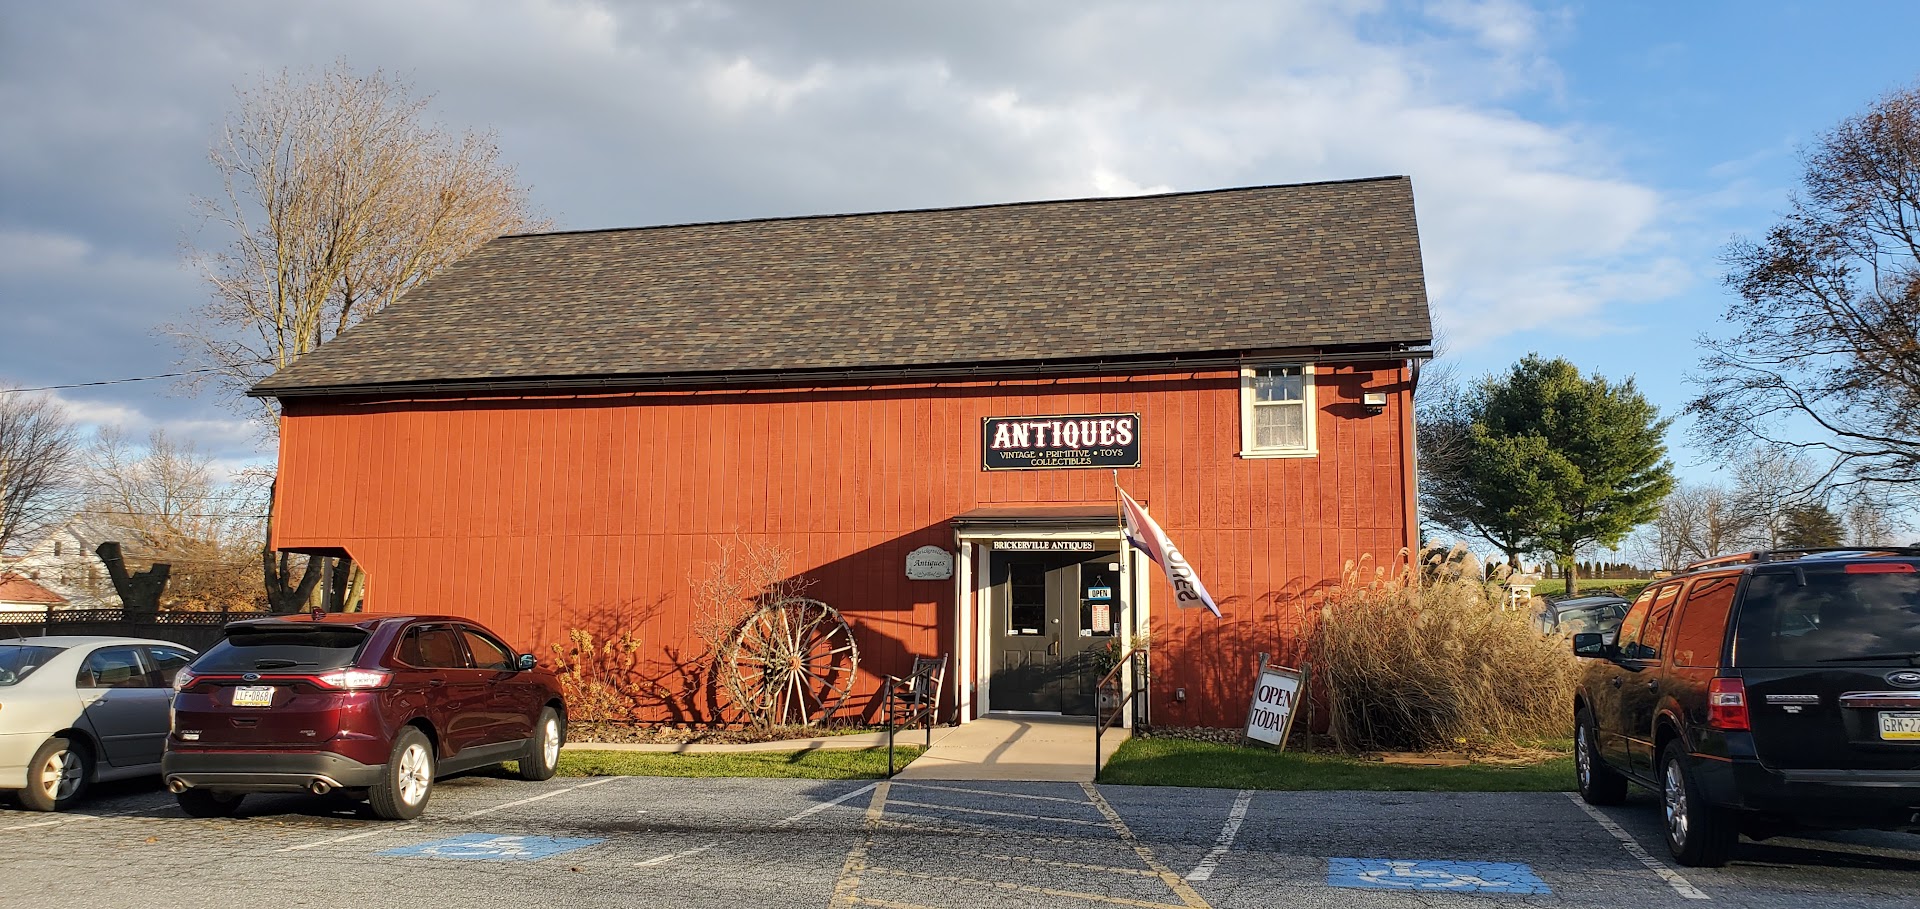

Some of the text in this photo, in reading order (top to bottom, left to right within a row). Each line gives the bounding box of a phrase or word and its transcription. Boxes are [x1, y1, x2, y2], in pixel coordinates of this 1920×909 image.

[991, 418, 1134, 449] ANTIQUES
[1000, 449, 1124, 459] VINTAGE PRIMITIVE TOYS
[1030, 458, 1092, 466] COLLECTIBLES
[993, 541, 1092, 550] BRICKERVILLE ANTIQUES
[913, 559, 946, 569] Antiques
[1091, 589, 1108, 598] OPEN
[1258, 685, 1295, 708] OPEN
[1251, 708, 1289, 733] TODAY
